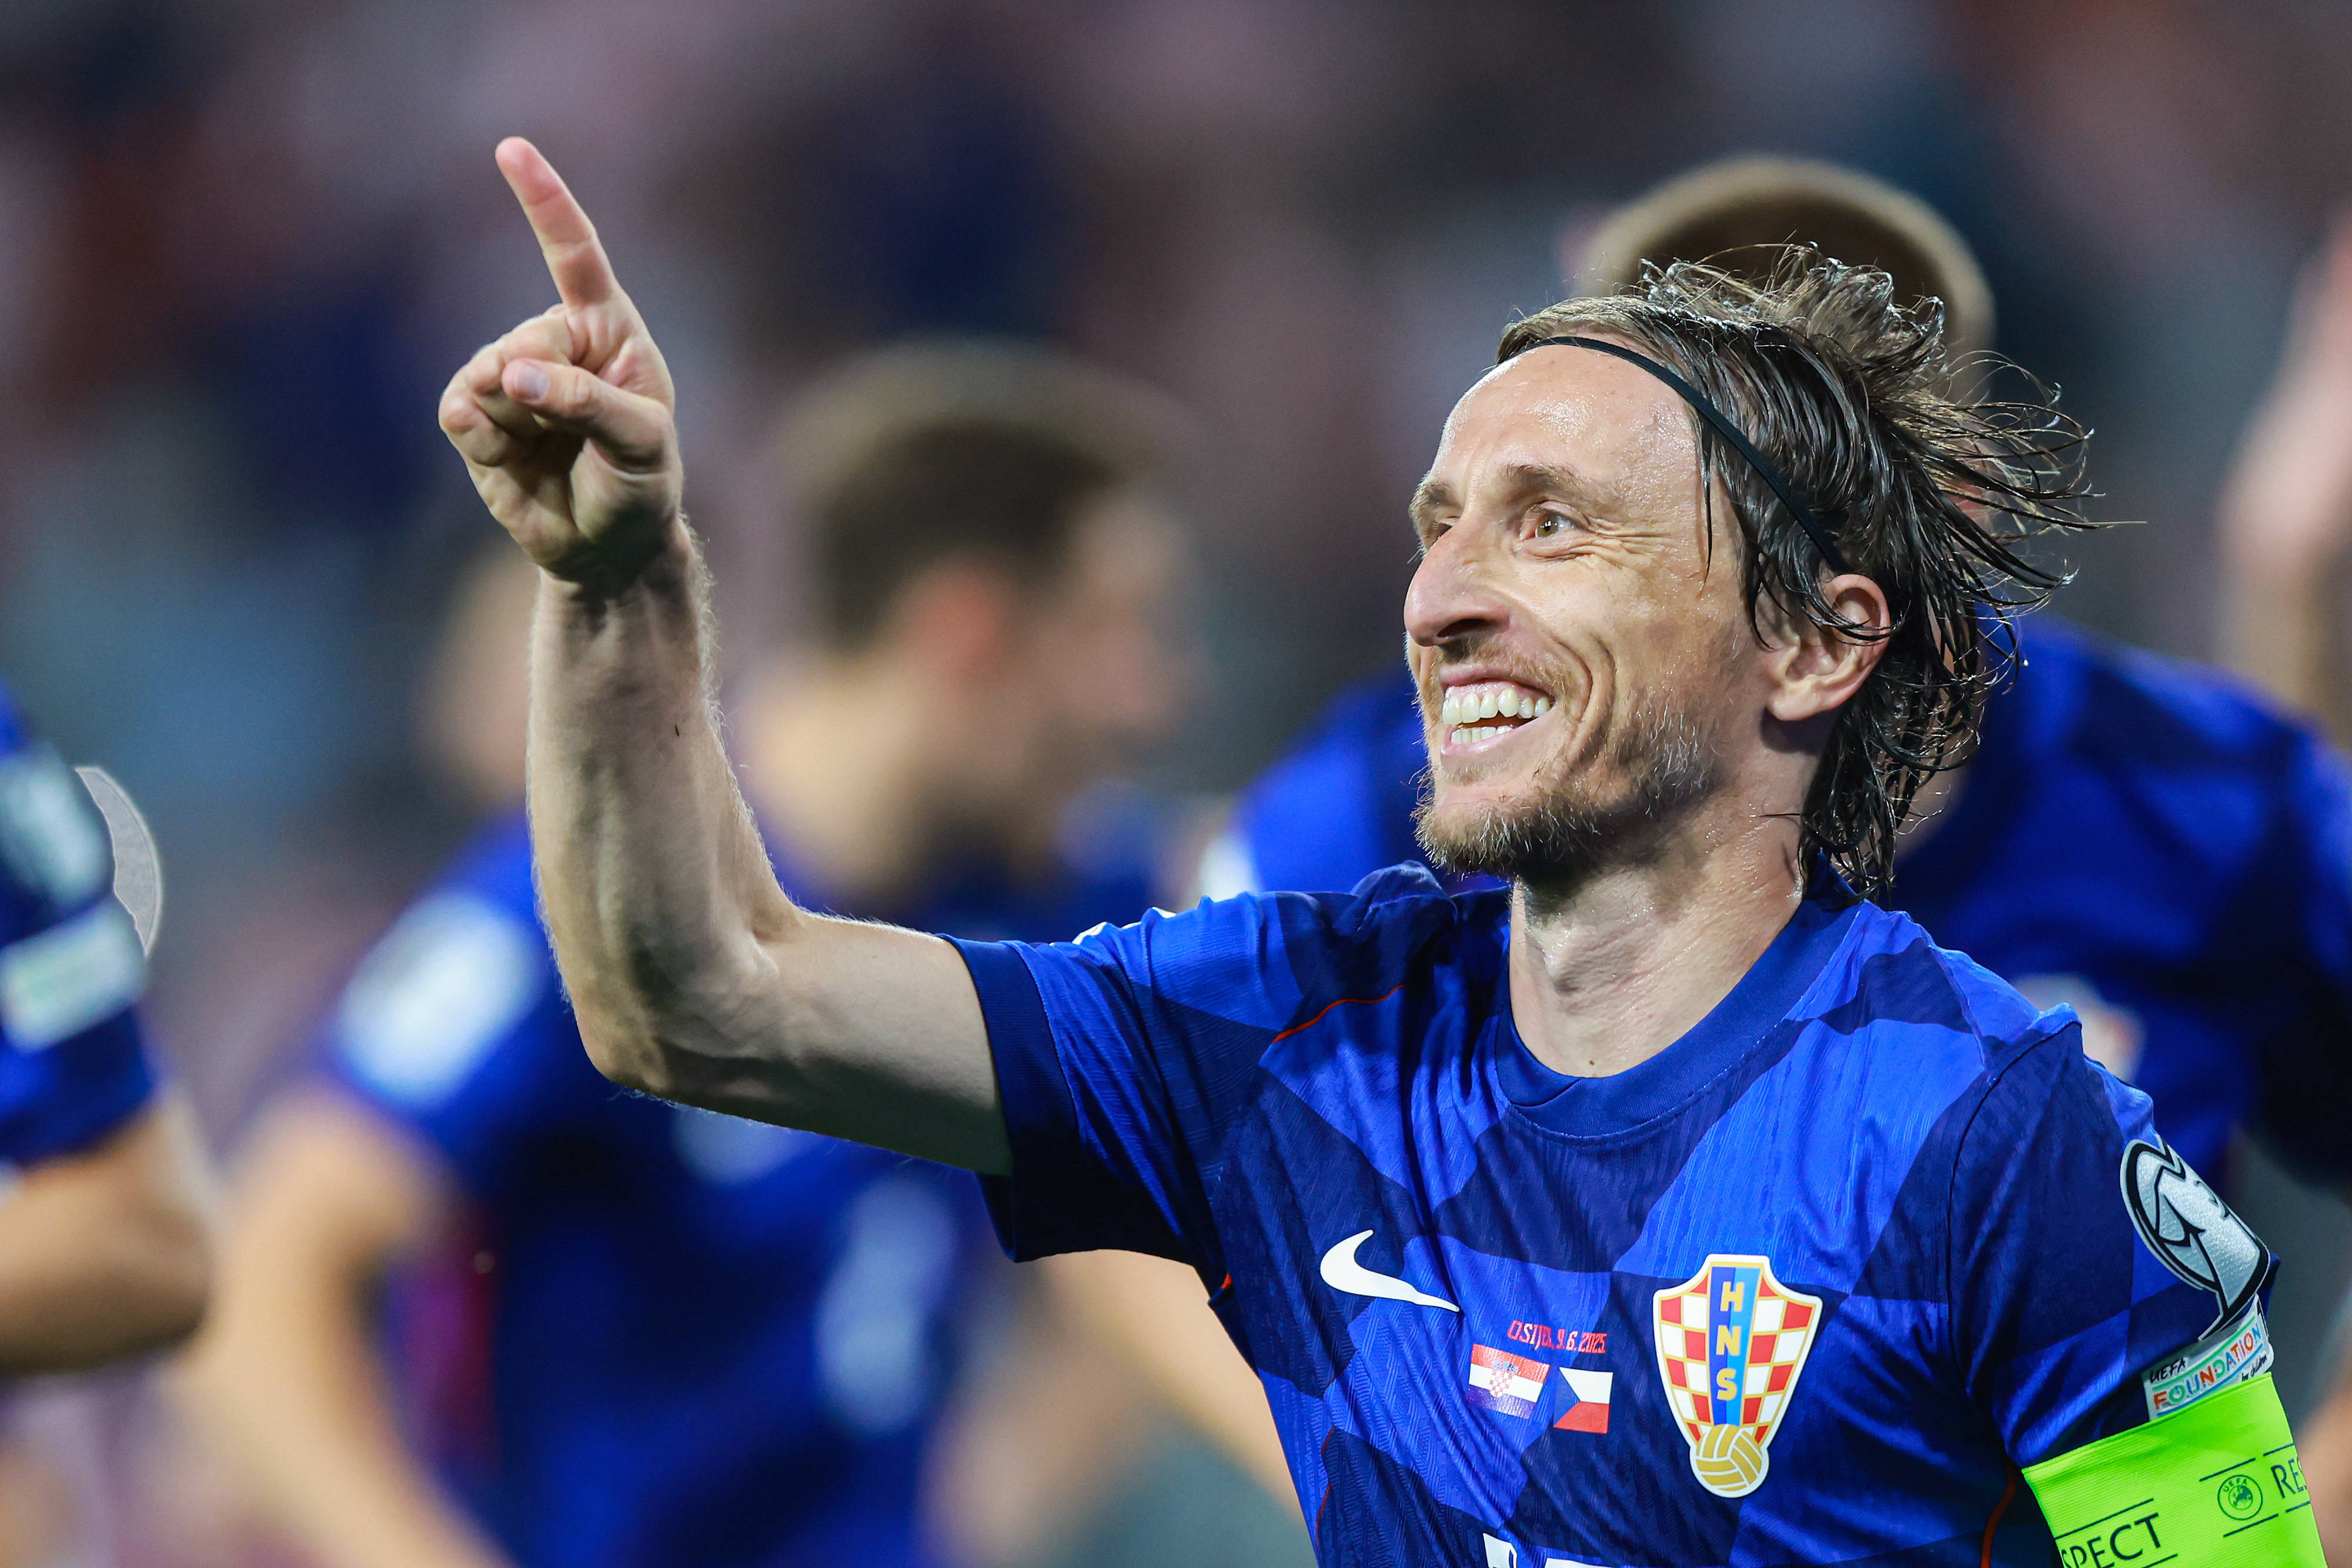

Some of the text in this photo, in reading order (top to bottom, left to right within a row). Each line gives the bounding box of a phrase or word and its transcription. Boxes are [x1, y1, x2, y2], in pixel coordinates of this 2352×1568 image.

[1715, 1282, 1744, 1400] HNS
[2149, 1358, 2186, 1383] UEFA
[2153, 1322, 2262, 1410] FOUNDATION
[2223, 1477, 2248, 1492] UEFA
[2270, 1456, 2307, 1499] RE
